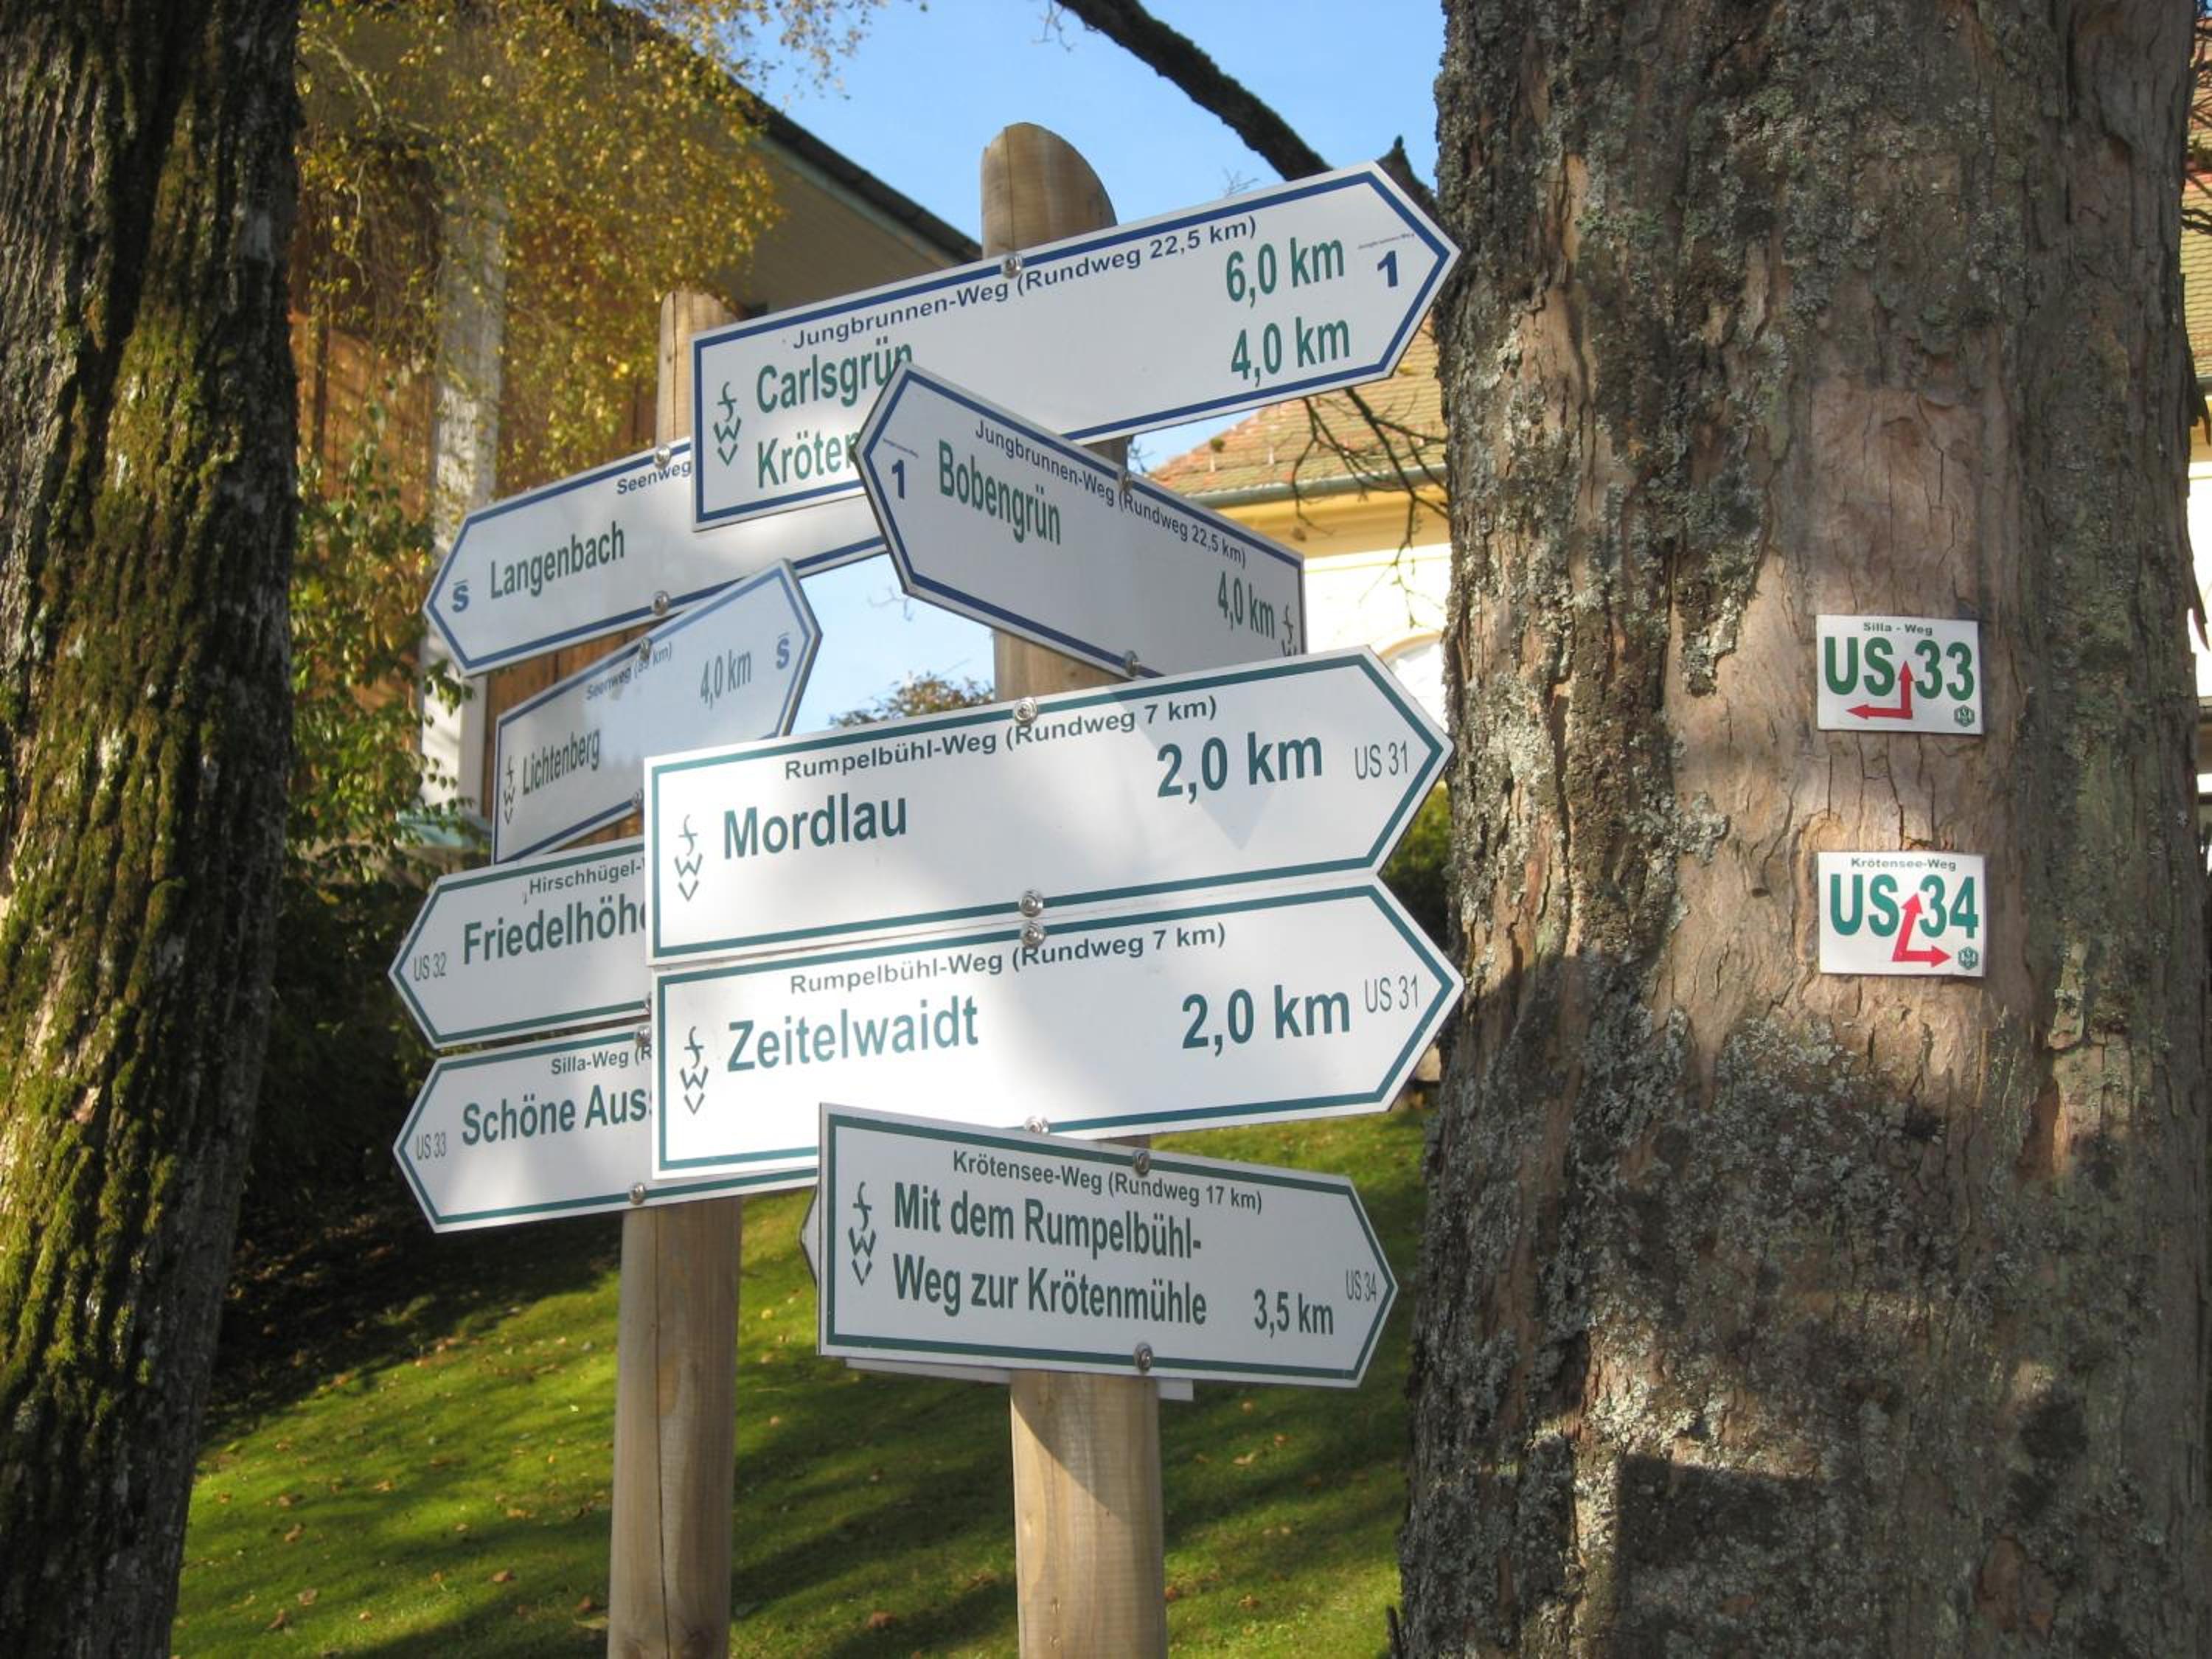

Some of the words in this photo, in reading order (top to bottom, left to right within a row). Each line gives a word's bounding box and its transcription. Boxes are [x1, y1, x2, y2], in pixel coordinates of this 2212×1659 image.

[793, 280, 1009, 349] Jungbrunnen-Weg
[1017, 248, 1141, 296] (Rundweg
[1150, 230, 1201, 260] 22,5
[1209, 216, 1256, 244] km)
[1226, 243, 1277, 308] 6,0
[1290, 237, 1345, 288] km
[1377, 250, 1398, 288] 1
[1231, 323, 1281, 387] 4,0
[1295, 316, 1350, 368] km
[616, 461, 692, 494] Seenweg
[891, 459, 905, 499] 1
[939, 440, 1061, 546] Bobengrün
[975, 420, 1115, 507] Jungbrunnen-Weg
[1119, 492, 1188, 542] (Rundweg
[1192, 525, 1219, 552] 22,5
[1222, 538, 1246, 569] km)
[490, 521, 625, 599] Langenbach
[1218, 571, 1244, 632] 4,0
[1249, 582, 1275, 640] km
[1863, 622, 1892, 632] Silla
[1905, 625, 1933, 636] Weg
[653, 641, 672, 667] km)
[700, 655, 723, 710] 4,0
[728, 649, 751, 692] km
[1825, 637, 1895, 696] US
[1915, 640, 1975, 701] 33
[521, 728, 600, 796] Lichtenberg
[785, 733, 997, 779] Rumpelbühl-Weg
[1006, 712, 1135, 751] (Rundweg
[1144, 704, 1158, 725] 7
[1167, 695, 1217, 722] km)
[1354, 745, 1382, 779] US
[1388, 741, 1409, 776] 31
[723, 793, 907, 860] Mordlau
[1157, 737, 1228, 804] 2,0
[1248, 731, 1322, 786] km
[529, 858, 645, 894] Hirschhügel-
[1851, 858, 1956, 871] Krötensee-Weg
[464, 893, 645, 964] Friedelhöh
[1830, 874, 1899, 937] US
[1919, 874, 1978, 939] 34
[413, 955, 430, 982] US
[432, 951, 447, 977] 32
[790, 952, 1004, 995] Rumpelbühl-Weg
[1012, 937, 1143, 973] (Rundweg
[1153, 930, 1166, 950] 7
[1176, 922, 1226, 949] km)
[1364, 977, 1392, 1013] US
[1398, 974, 1419, 1009] 31
[727, 995, 978, 1073] Zeitelwaidt
[1181, 988, 1254, 1057] 2,0
[1273, 984, 1350, 1040] km
[552, 1050, 628, 1075] Silla-Weg
[415, 1135, 431, 1161] US
[433, 1133, 446, 1157] 33
[462, 1094, 575, 1145] Schöne
[585, 1085, 652, 1129] Aus
[953, 1150, 1102, 1195] Krötensee-Weg
[1108, 1171, 1199, 1207] (Rundweg
[1206, 1185, 1224, 1205] 17
[1231, 1189, 1262, 1215] km)
[894, 1181, 941, 1233] Mit
[950, 1190, 1014, 1240] dem
[1025, 1198, 1201, 1260] Rumpelbühl-
[893, 1253, 961, 1317] Weg
[971, 1271, 1018, 1309] zur
[1028, 1267, 1207, 1324] Krötenmühle
[1253, 1289, 1290, 1338] 3,5
[1298, 1293, 1334, 1335] km
[1345, 1269, 1363, 1301] US
[1364, 1273, 1377, 1301] 34
